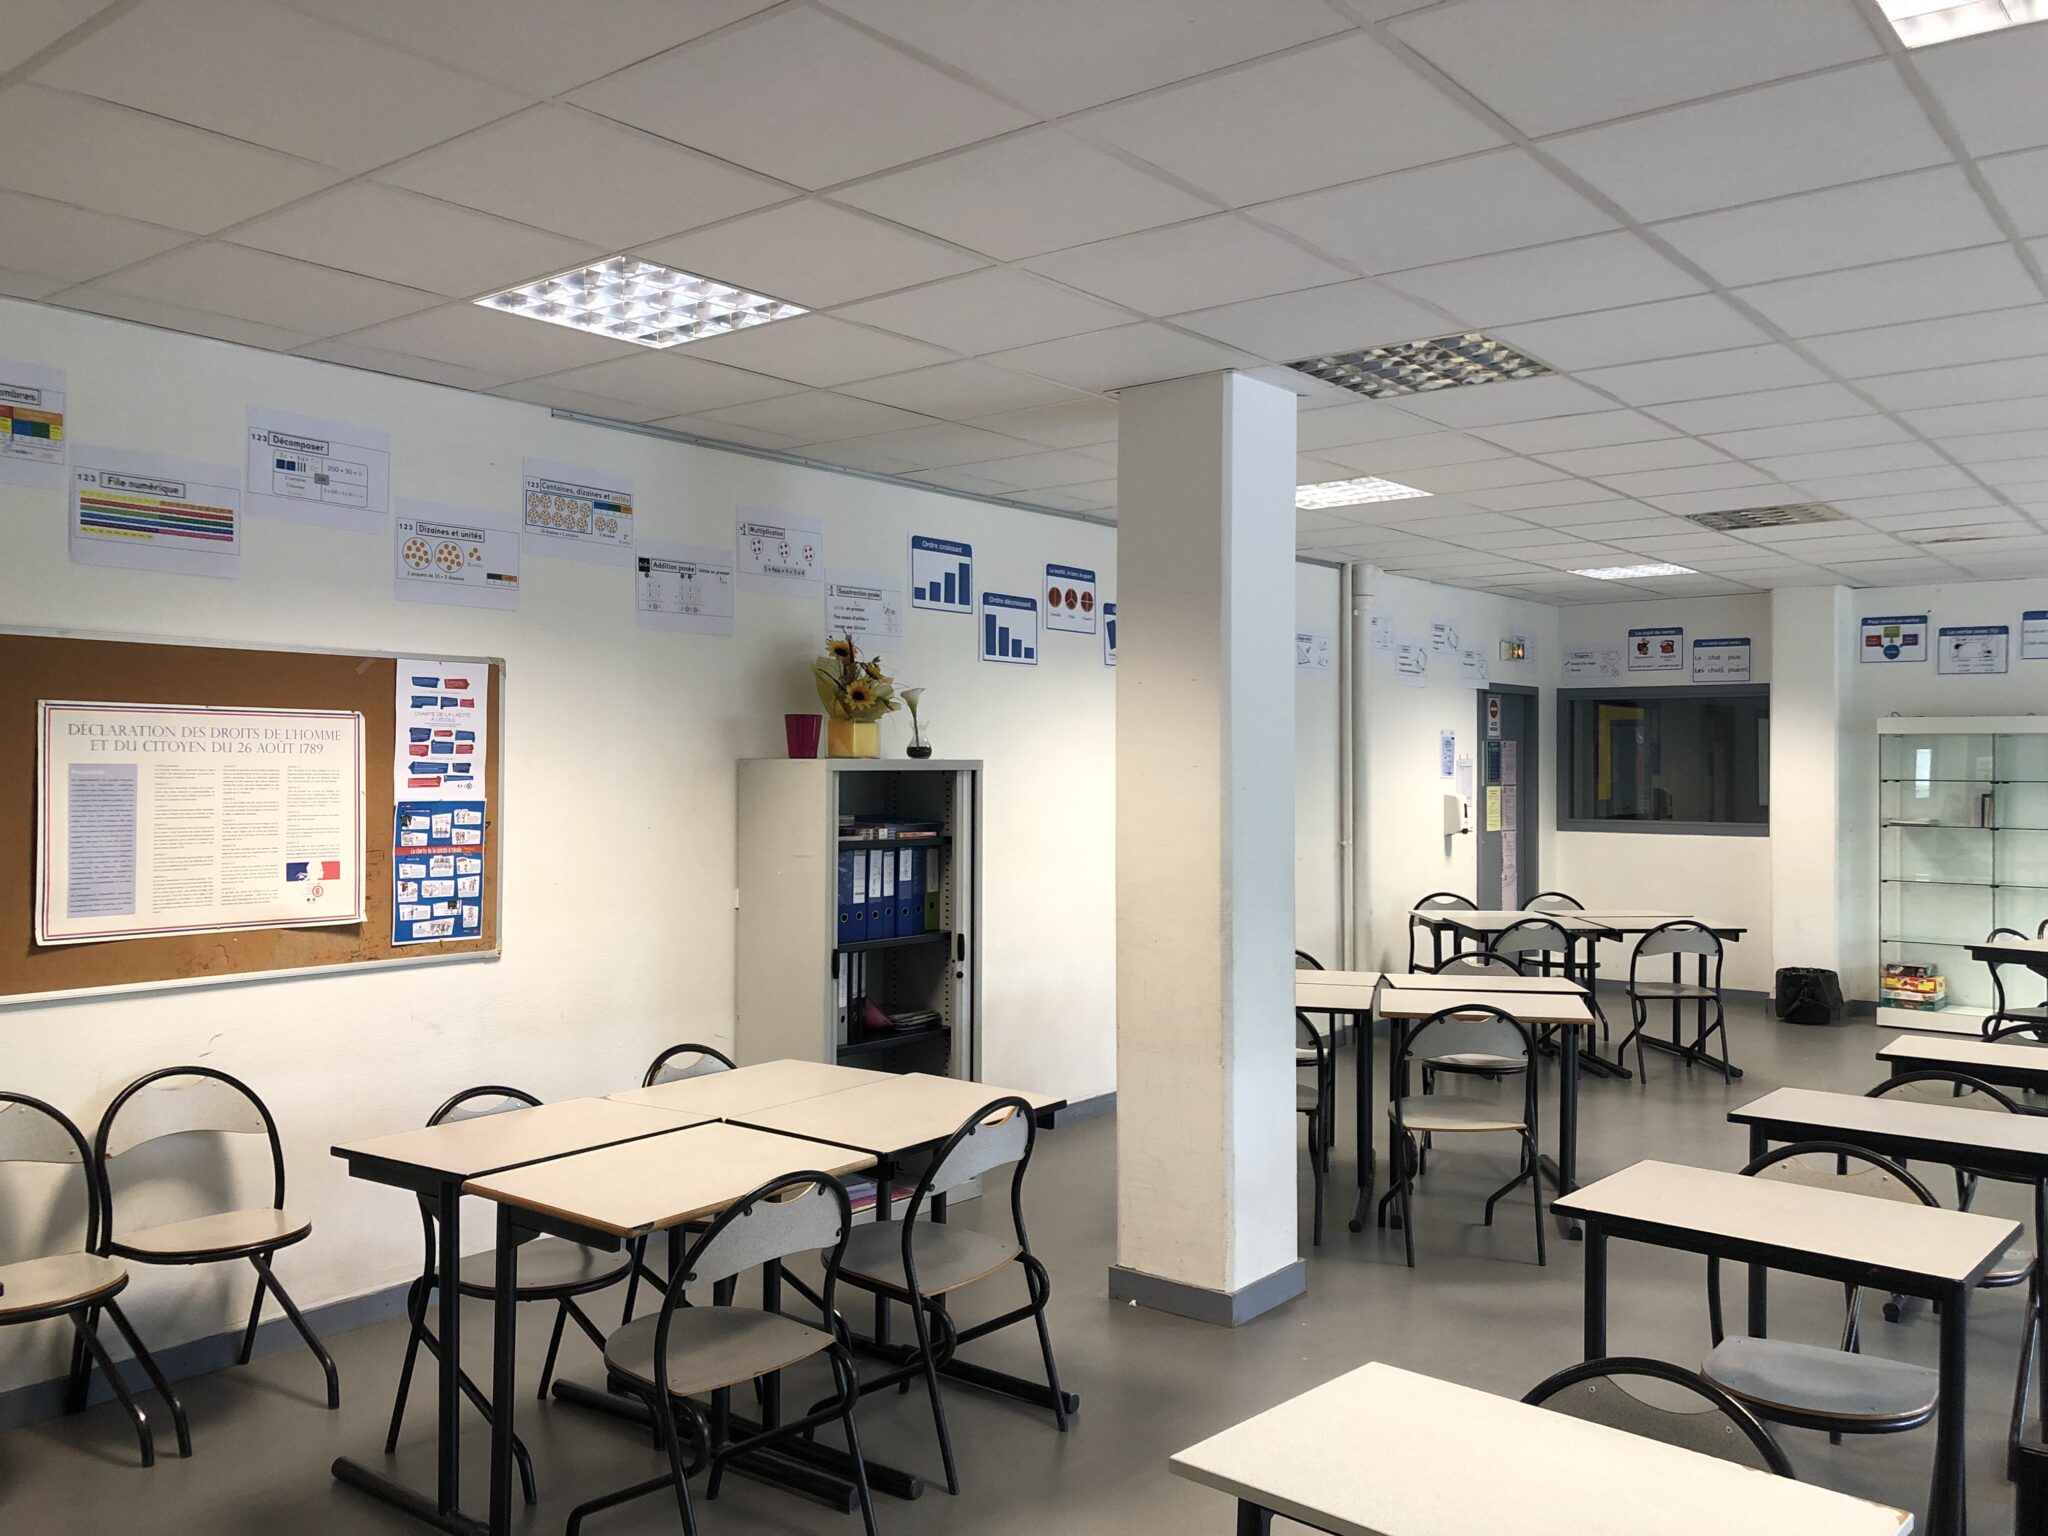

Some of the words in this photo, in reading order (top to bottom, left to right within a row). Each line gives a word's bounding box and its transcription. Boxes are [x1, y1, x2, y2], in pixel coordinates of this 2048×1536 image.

[272, 435, 324, 452] Décomposer
[576, 488, 602, 499] dizaines
[418, 524, 450, 536] Dizaines
[461, 530, 482, 540] unités
[939, 544, 962, 553] croissant
[654, 562, 677, 572] Addition
[68, 722, 176, 738] DÉCLARATION
[181, 726, 206, 738] DES
[210, 726, 260, 739] DROITS
[264, 728, 284, 740] DE
[286, 728, 341, 741] L'HOMME
[90, 739, 108, 752] ET
[114, 740, 137, 752] DU
[142, 740, 207, 753] CITOYEN
[212, 741, 232, 753] DU
[236, 742, 252, 754] 26
[256, 740, 295, 754] AOÛT
[298, 744, 324, 754] 1789
